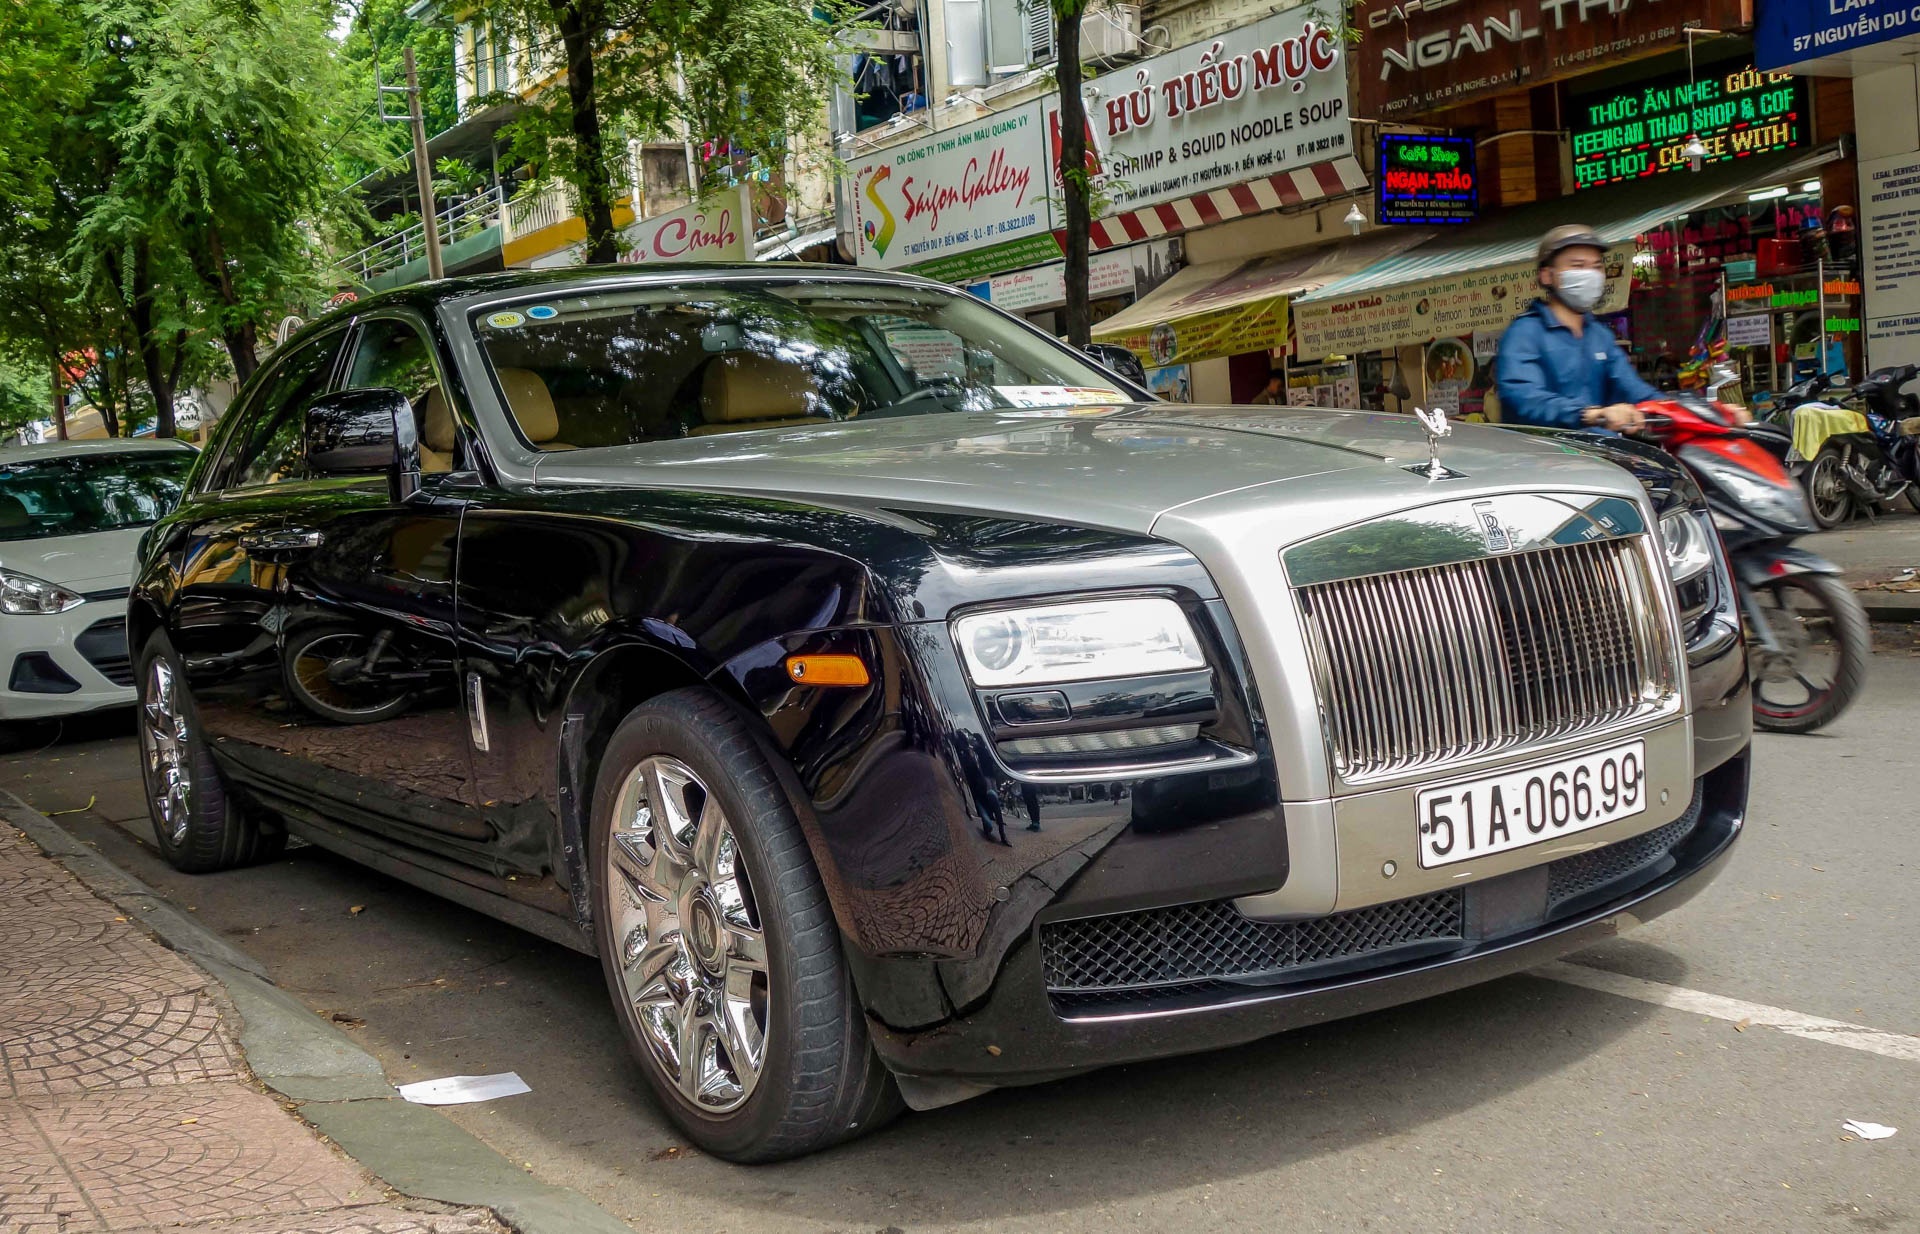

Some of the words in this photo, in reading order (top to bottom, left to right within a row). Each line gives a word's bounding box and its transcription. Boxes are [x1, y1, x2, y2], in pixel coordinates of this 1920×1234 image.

[1793, 35, 1811, 52] 57
[1814, 13, 1880, 47] NGUYỄN
[1883, 9, 1907, 29] DU
[1104, 68, 1155, 137] HỦ
[1161, 40, 1248, 118] TIẾU
[1251, 21, 1338, 92] MỰC
[1643, 87, 1671, 114] ĂN
[1647, 112, 1689, 139] THAO
[1693, 101, 1737, 130] SHOP
[1741, 97, 1755, 119] &
[896, 154, 906, 166] CN
[908, 148, 925, 162] CÔNG
[926, 144, 935, 157] TY
[937, 139, 956, 154] TNHH
[992, 119, 1017, 137] QUANG
[1018, 114, 1028, 128] VY
[1113, 150, 1163, 178] SHRIMP
[1168, 146, 1178, 164] &
[1182, 131, 1225, 159] SQUID
[1230, 112, 1293, 145] NOODLE
[1299, 98, 1343, 125] SOUP
[1431, 146, 1460, 167] Shop
[1731, 122, 1789, 152] WITH
[962, 147, 1030, 211] Gallery
[1162, 175, 1181, 192] QUANG
[1181, 174, 1189, 187] VY
[1223, 163, 1232, 175] DU
[931, 239, 938, 250] DU
[1428, 752, 1639, 857] 51A-066.99
